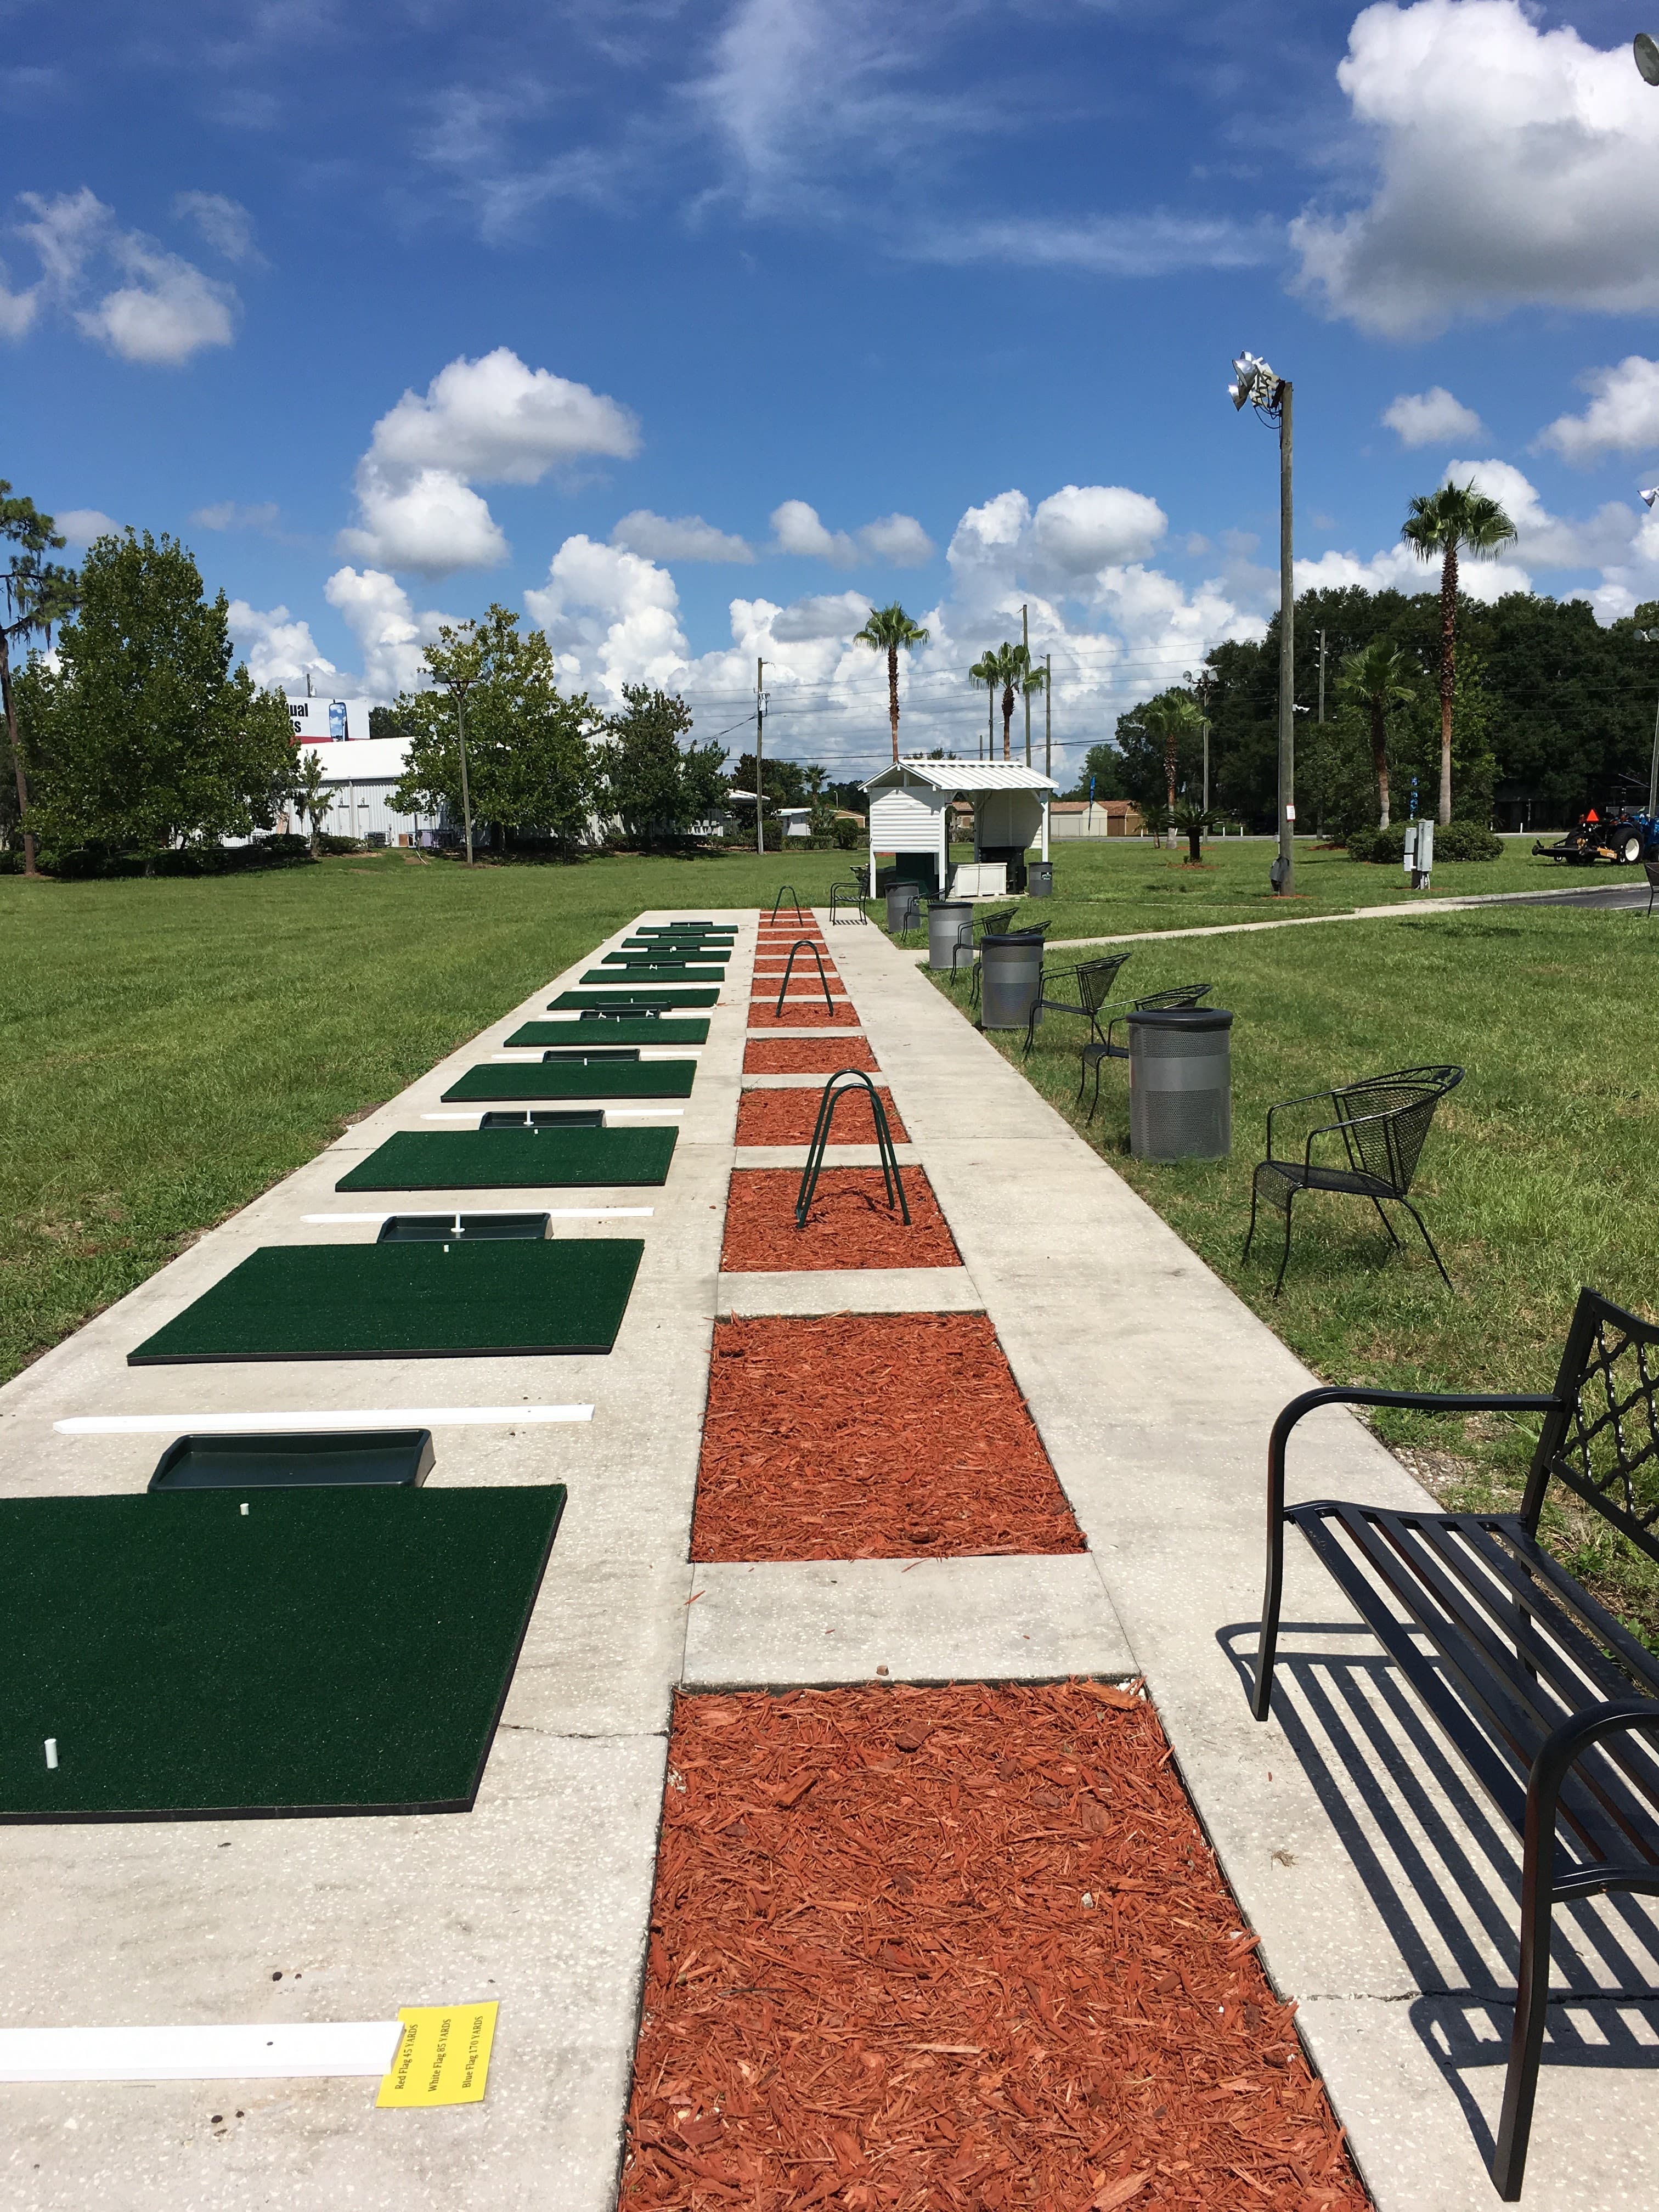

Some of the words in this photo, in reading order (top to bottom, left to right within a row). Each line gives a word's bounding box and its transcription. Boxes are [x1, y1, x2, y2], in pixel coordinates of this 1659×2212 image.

[438, 2019, 452, 2042] YARDS
[471, 2016, 483, 2039] YARDS
[405, 2024, 418, 2047] YARDS
[403, 2049, 413, 2057] 45
[436, 2043, 446, 2052] 85
[469, 2040, 479, 2053] 170
[398, 2059, 413, 2074] Flag
[433, 2053, 447, 2068] Flag
[465, 2054, 479, 2070] Flag
[394, 2075, 407, 2089] Red
[428, 2070, 441, 2092] White
[462, 2071, 473, 2089] Blue
